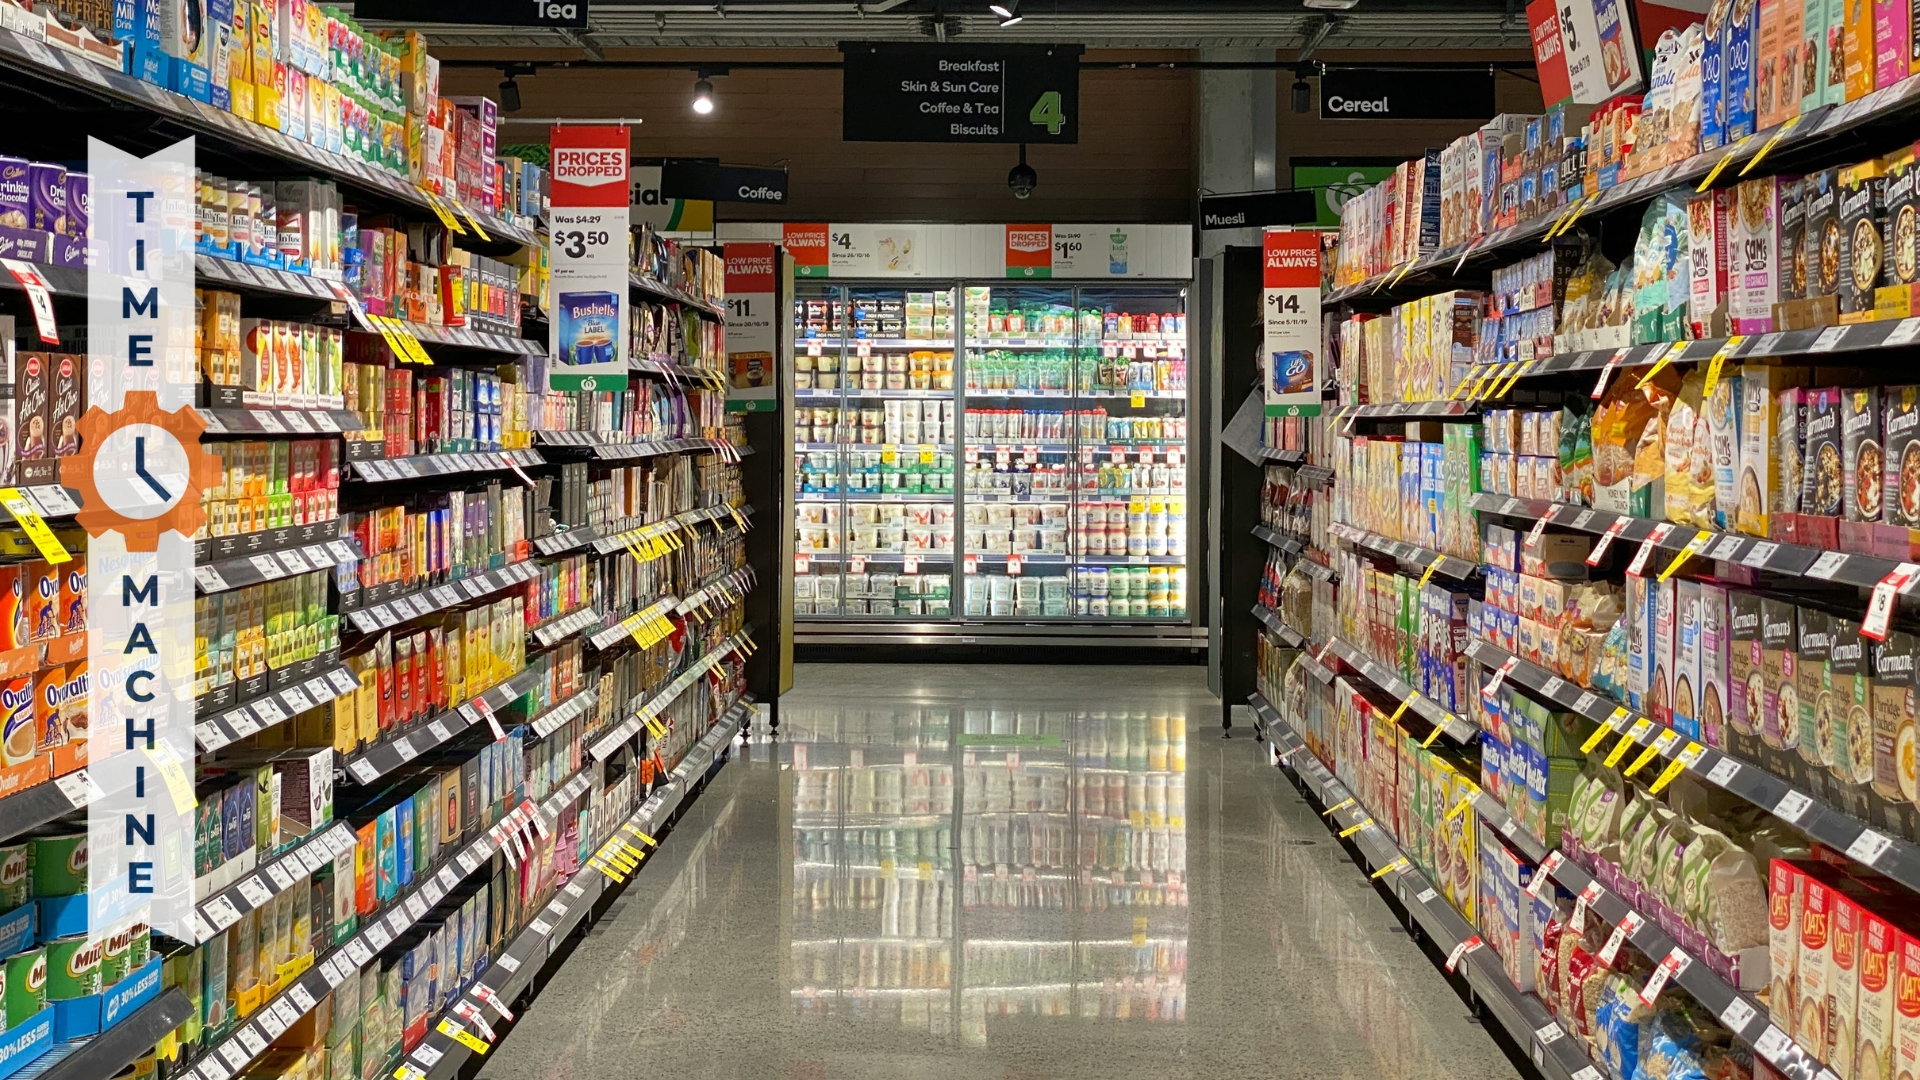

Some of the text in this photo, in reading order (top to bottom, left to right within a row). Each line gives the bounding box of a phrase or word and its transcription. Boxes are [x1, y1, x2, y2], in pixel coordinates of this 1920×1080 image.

[533, 0, 577, 19] Tea
[1537, 33, 1561, 64] ALWAYS
[939, 60, 1000, 72] Breakfast
[901, 80, 999, 93] Skin & Sun Care
[919, 102, 999, 114] Coffee & Tea
[1029, 91, 1065, 134] 4
[1328, 96, 1389, 113] Cereal
[950, 123, 999, 135] Biscuits
[558, 152, 622, 165] PRICES
[558, 166, 622, 177] DROPPED
[738, 186, 783, 200] Coffee
[555, 215, 574, 224] Was
[1205, 212, 1245, 227] Muesli
[786, 239, 826, 247] ALWAYS
[832, 233, 851, 250] $4
[1267, 249, 1317, 257] LOW PRICE
[726, 265, 773, 274] ALWAYS
[1267, 257, 1317, 267] ALWAYS
[573, 303, 615, 319] Bushells
[728, 299, 750, 316] $11
[1268, 294, 1300, 313] $14
[584, 326, 605, 334] LABEL
[1732, 606, 1758, 630] Carman's
[1763, 614, 1791, 638] Carman's
[1831, 635, 1862, 662] Carman's
[1771, 892, 1789, 917] OATS
[1803, 910, 1826, 937] OATS
[1834, 927, 1853, 955] OATS
[1863, 948, 1885, 977] OATS
[17, 1028, 37, 1052] LESS
